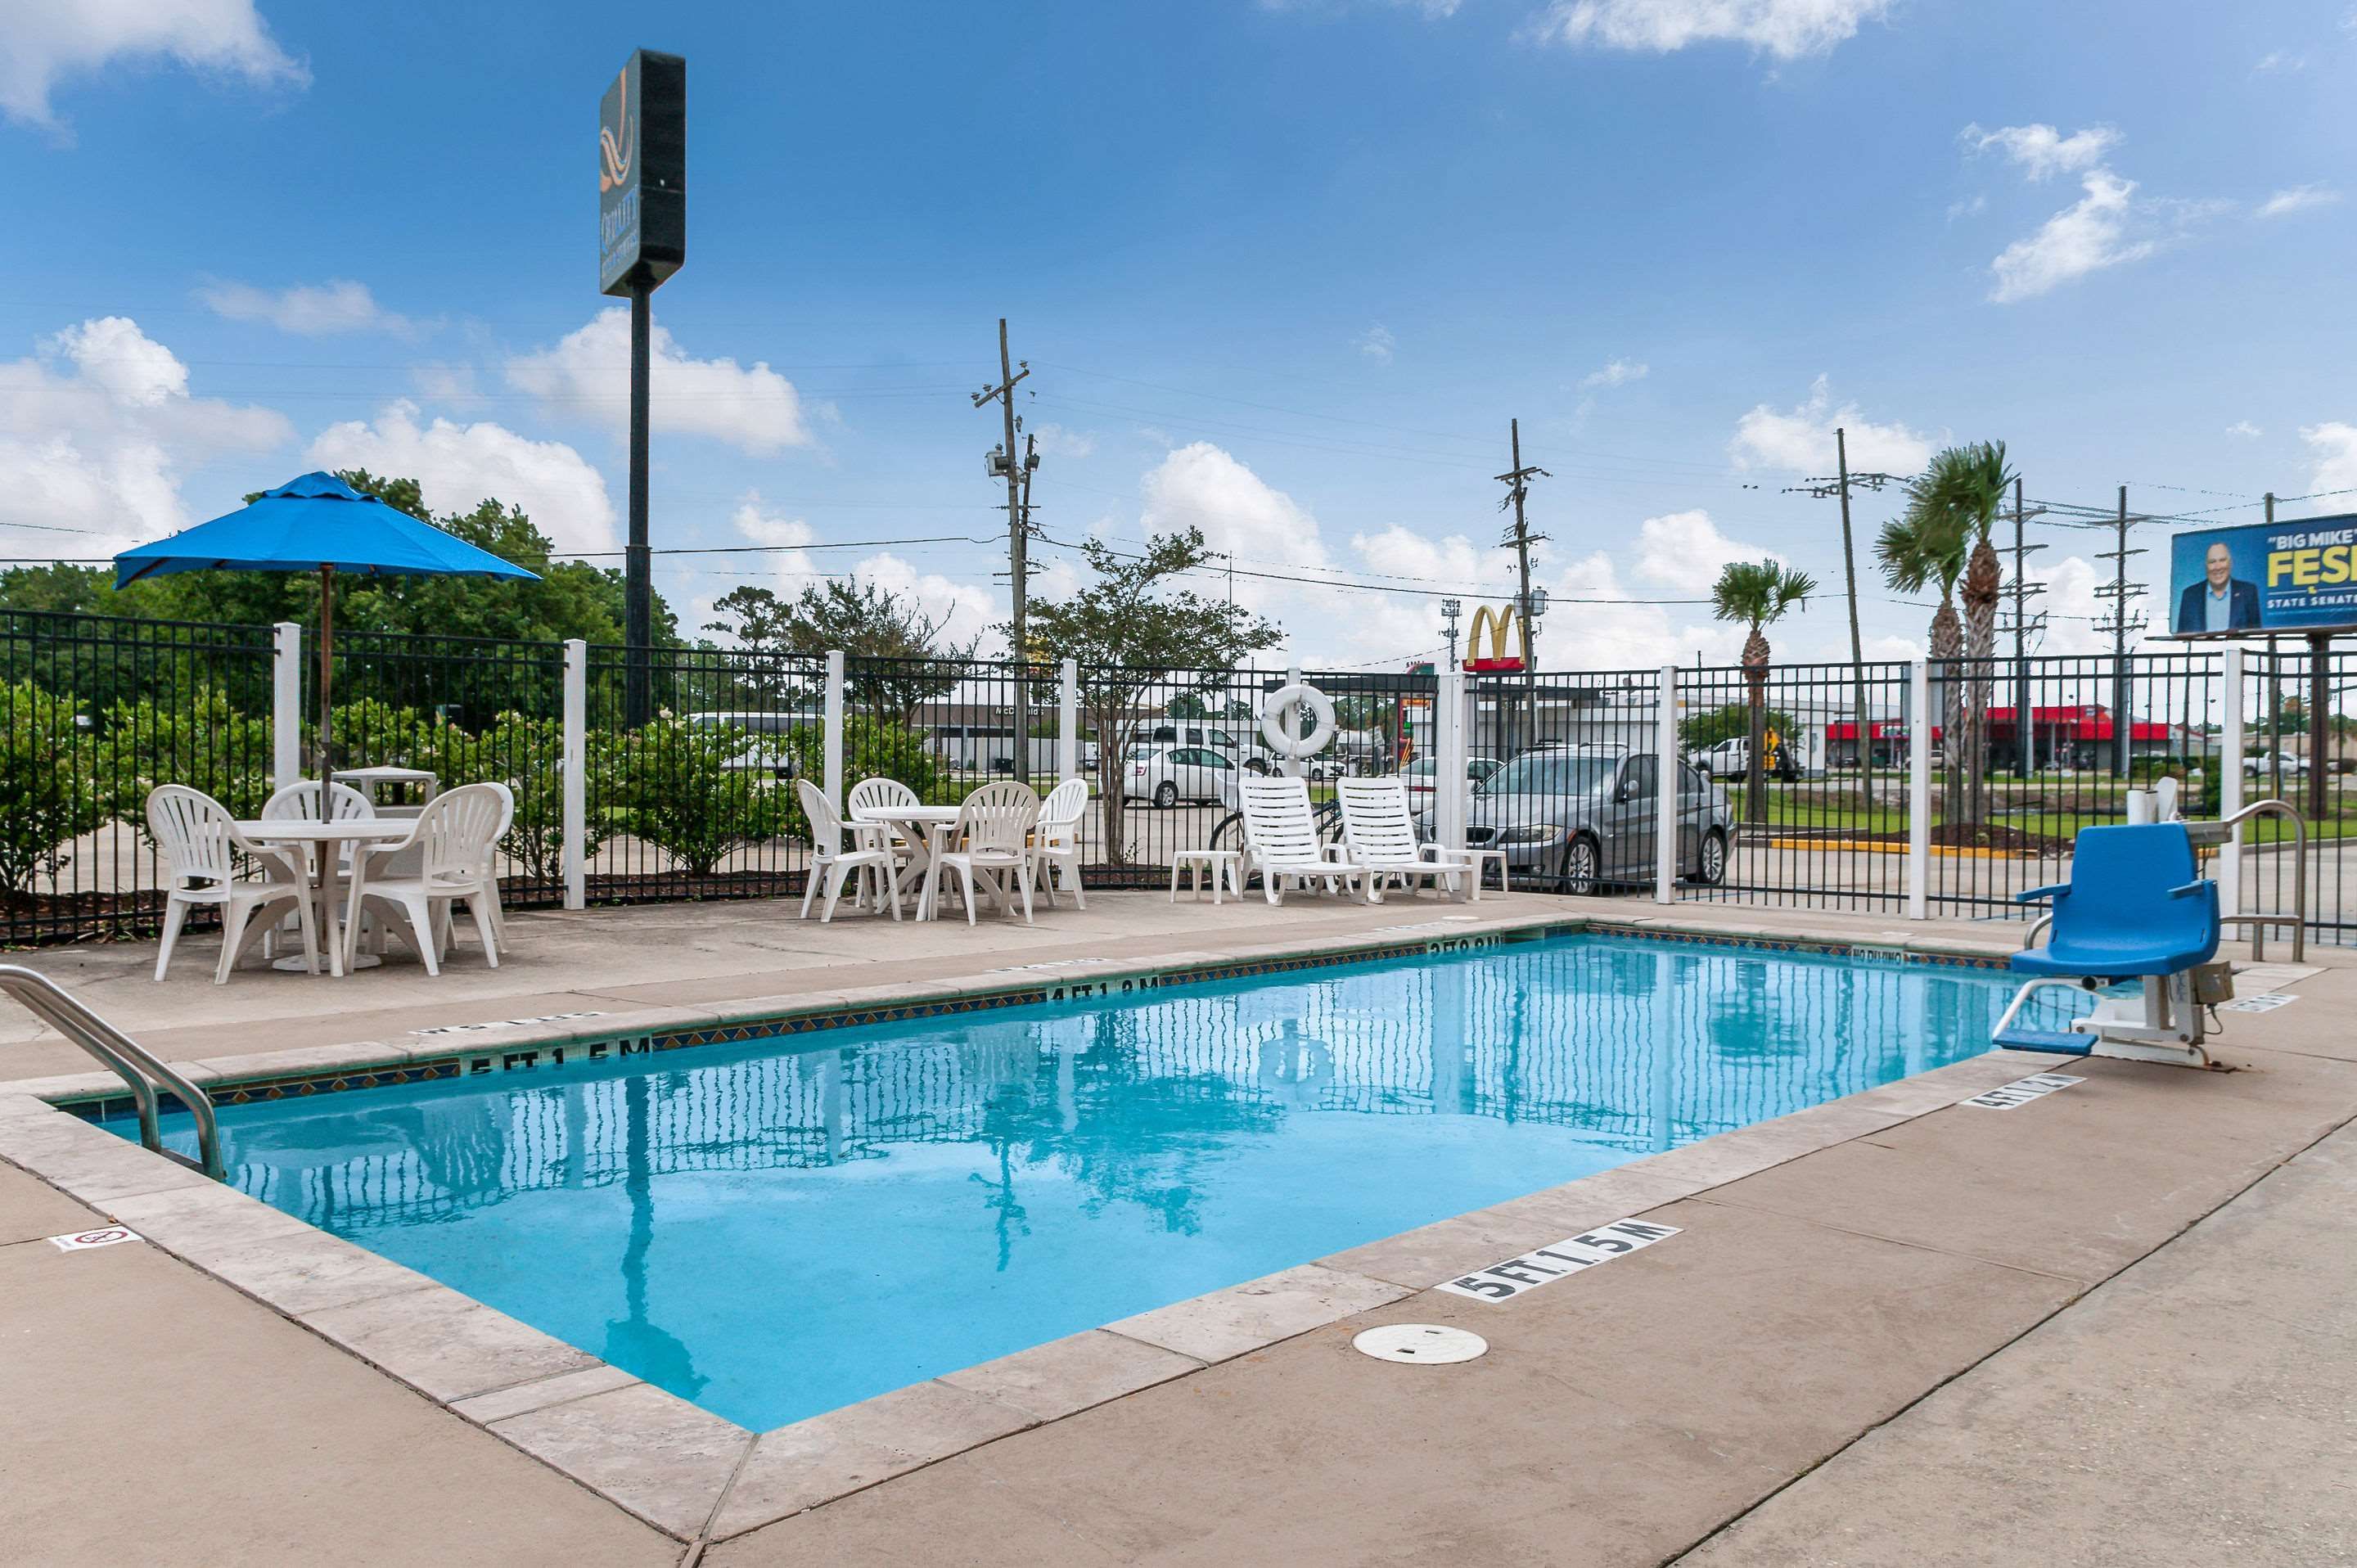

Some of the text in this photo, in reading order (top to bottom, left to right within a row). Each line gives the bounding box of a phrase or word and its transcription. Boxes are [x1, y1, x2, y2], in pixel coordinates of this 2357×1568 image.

[2266, 534, 2307, 550] "BIG
[2266, 597, 2306, 609] STATE
[1453, 1277, 1516, 1298] 5
[1608, 1222, 1673, 1241] M
